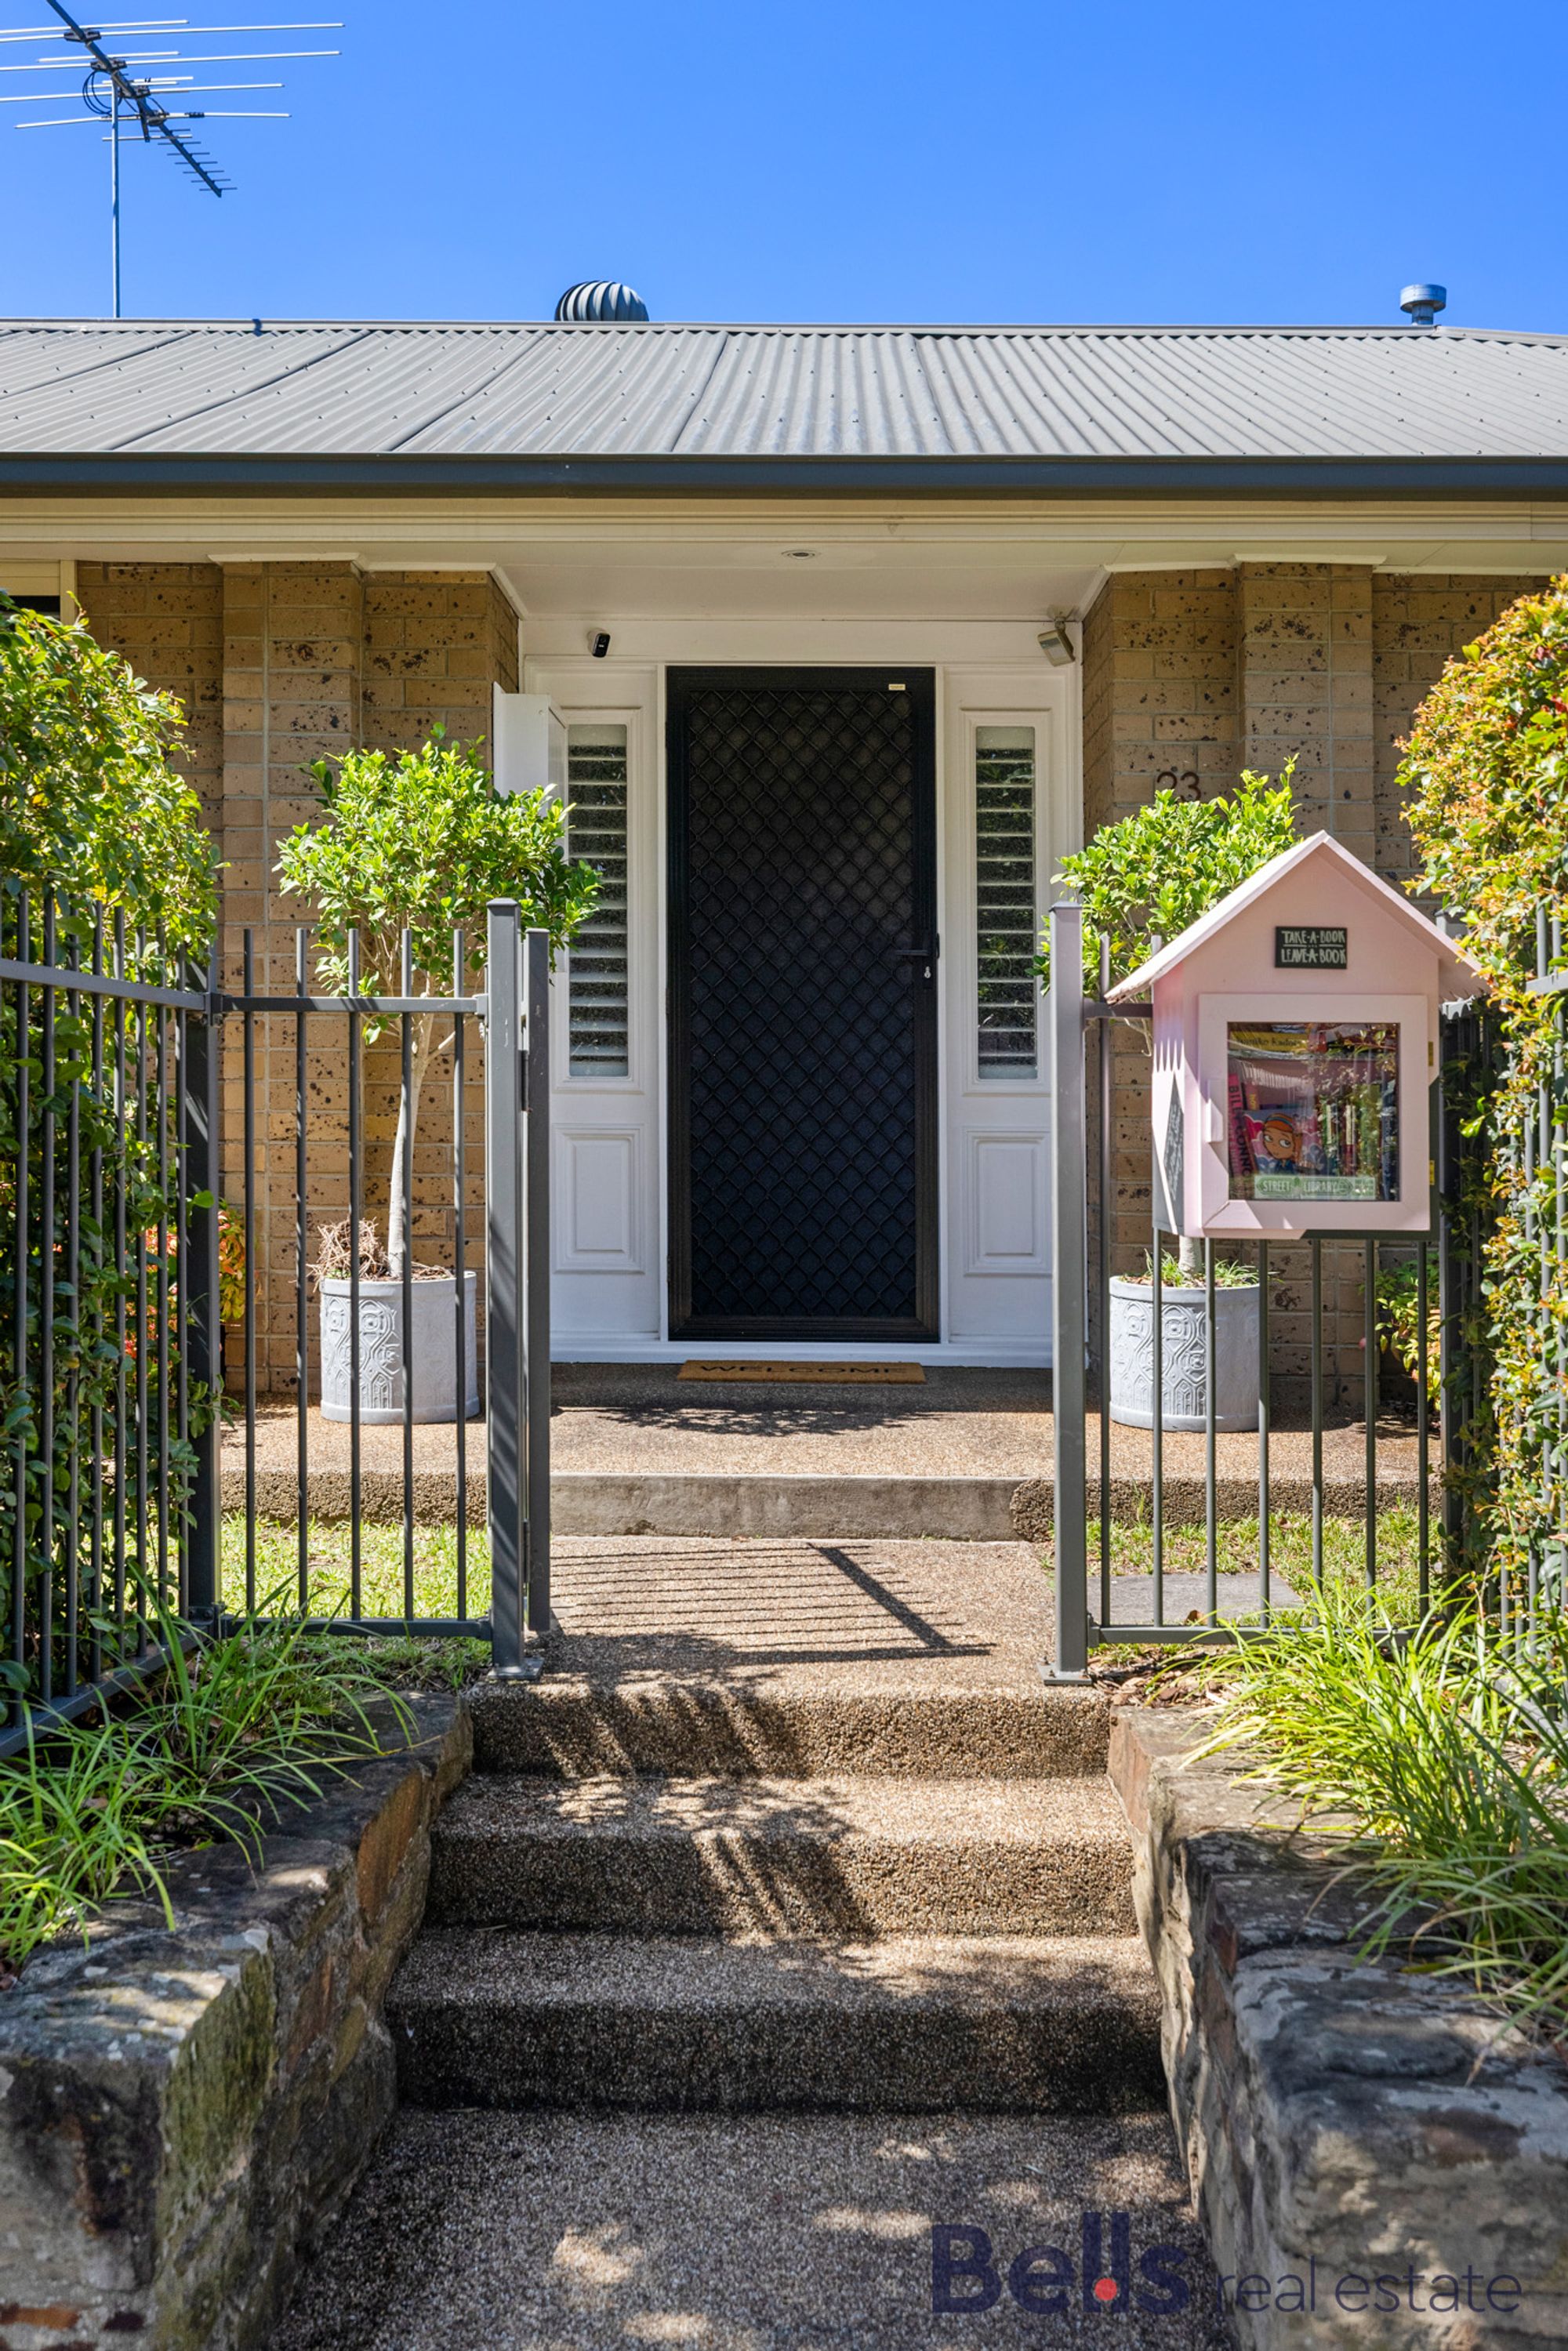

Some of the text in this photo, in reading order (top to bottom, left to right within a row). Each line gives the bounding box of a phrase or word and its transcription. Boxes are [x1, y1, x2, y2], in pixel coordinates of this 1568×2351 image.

[1262, 1181, 1338, 1192] STREET LIBRARY
[700, 1365, 907, 1374] WELCOME
